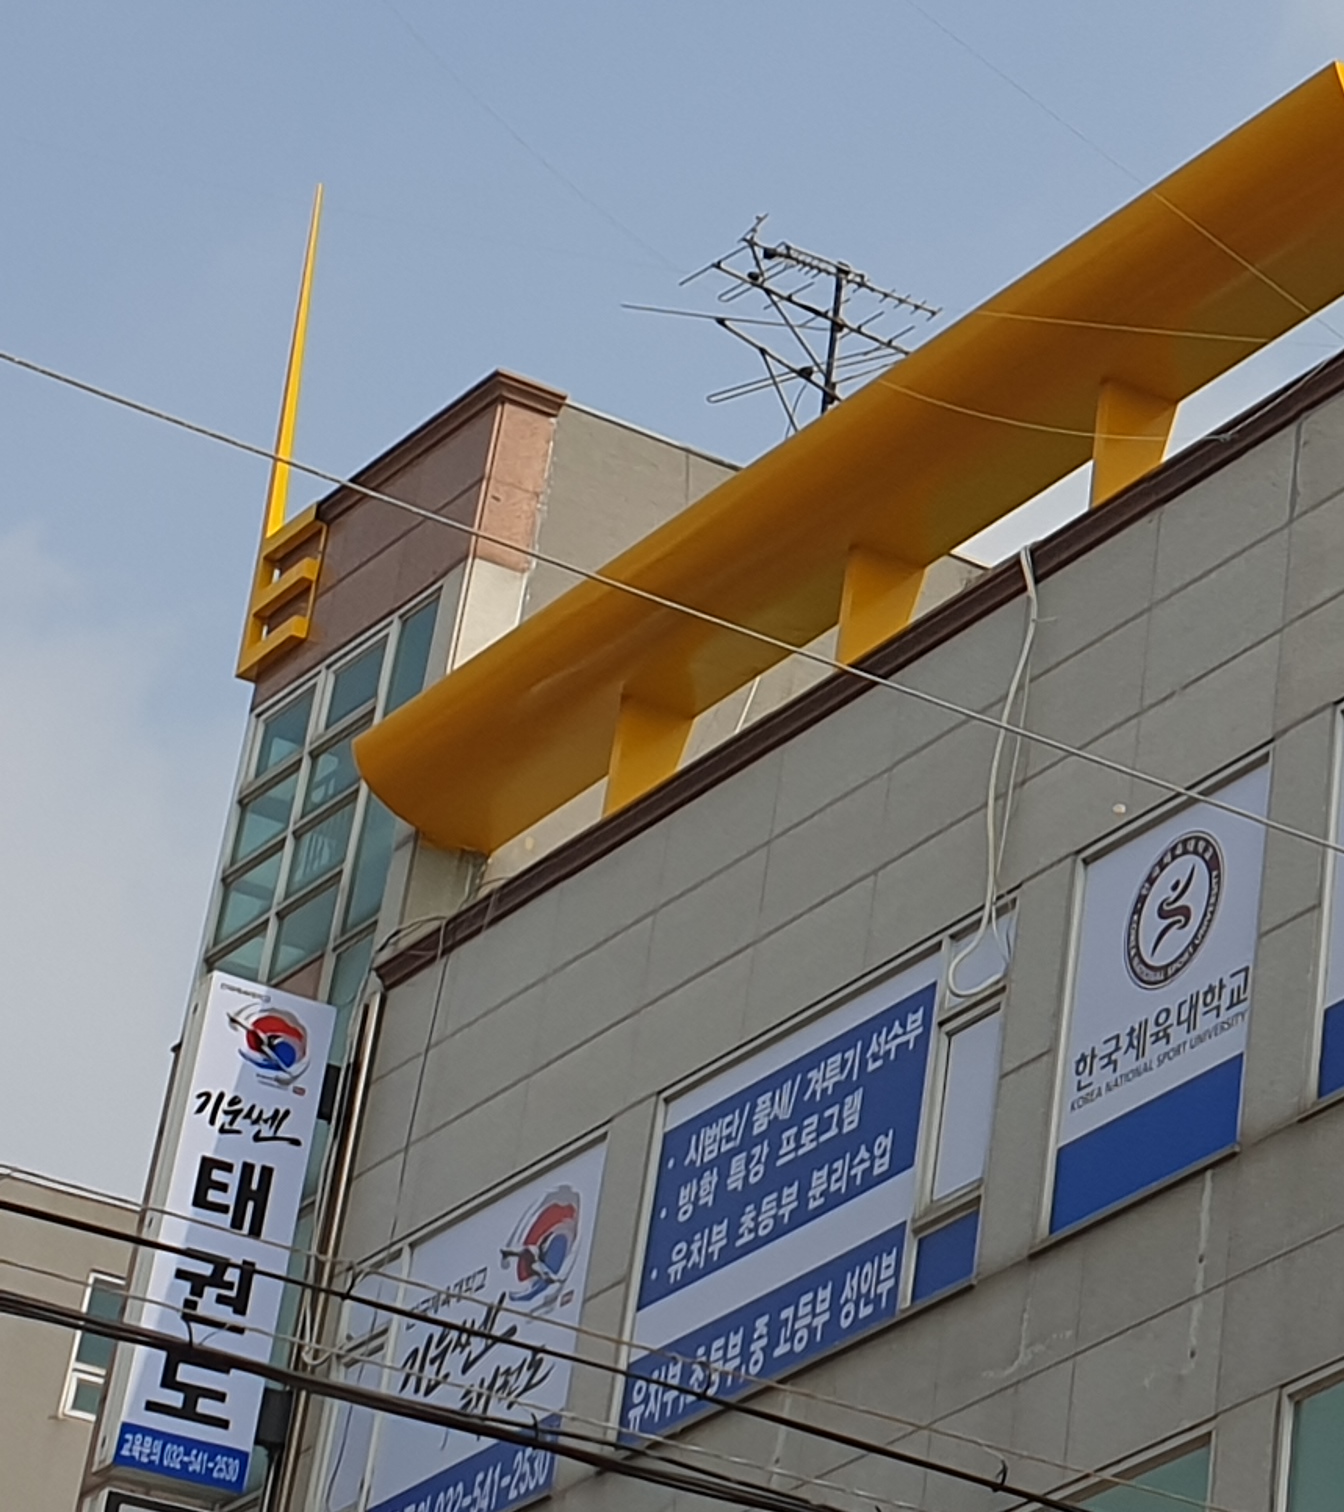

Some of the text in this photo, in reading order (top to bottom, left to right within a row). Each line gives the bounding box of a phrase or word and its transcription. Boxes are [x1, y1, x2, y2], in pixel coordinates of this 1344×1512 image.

[803, 1040, 862, 1102] 겨루기
[866, 1006, 924, 1072] 선수부
[1070, 1007, 1250, 1113] KOREA NATIONAL SPORT UNIVERSITY
[1074, 965, 1250, 1092] 한국체육대학교
[667, 1128, 894, 1284] 유치부 초등부 분리수업
[677, 1087, 864, 1223] 방학 특강 프로그램
[839, 1246, 897, 1329] 성인부
[120, 1433, 240, 1483] 교육문의 032-541-2530
